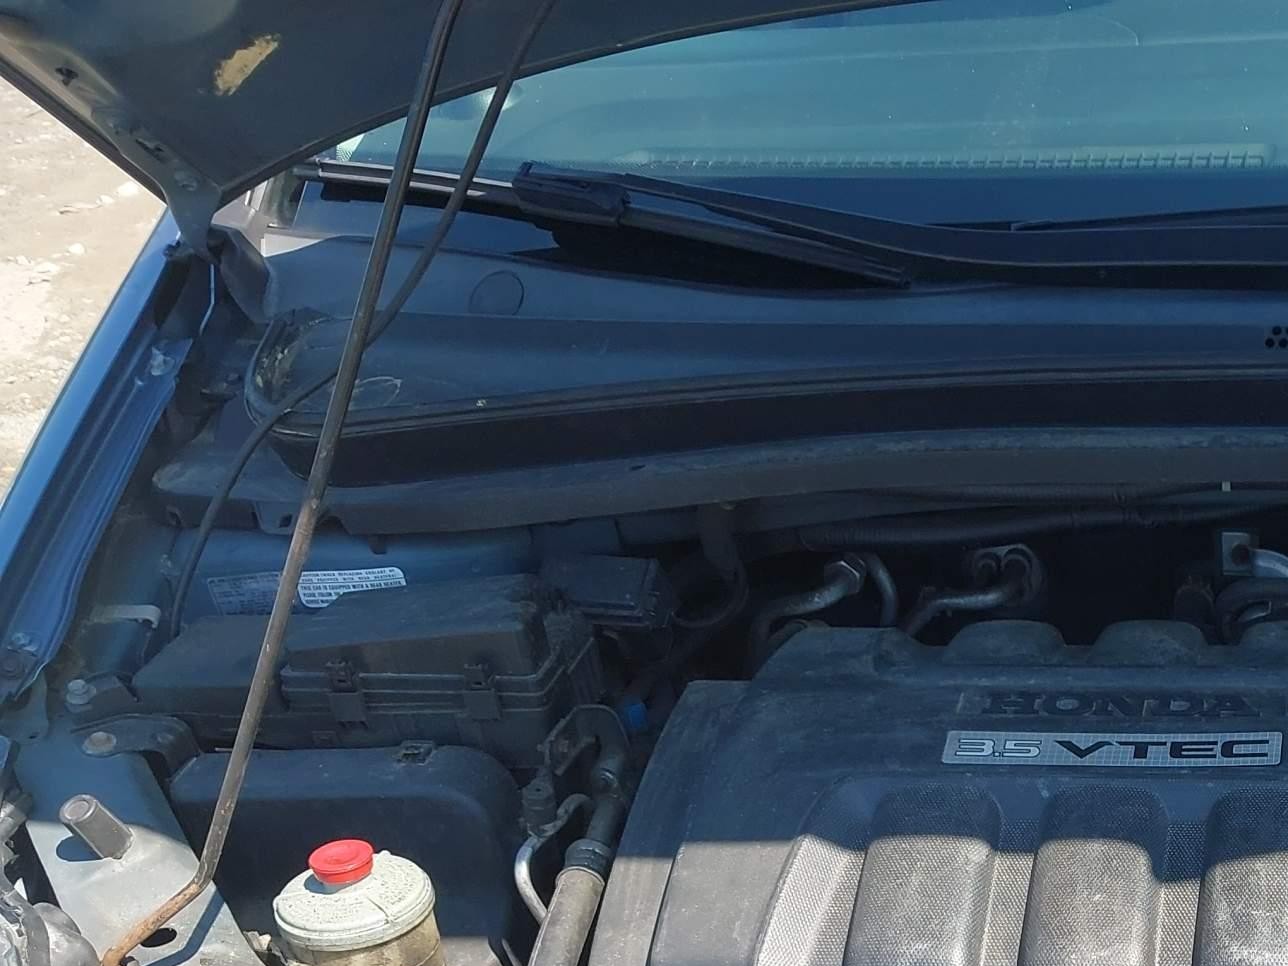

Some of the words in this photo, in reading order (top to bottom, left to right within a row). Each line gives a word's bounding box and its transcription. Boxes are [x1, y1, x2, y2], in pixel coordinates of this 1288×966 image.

[982, 690, 1261, 717] HONDA
[955, 738, 1042, 758] 3.5
[1055, 740, 1269, 759] VTEC
